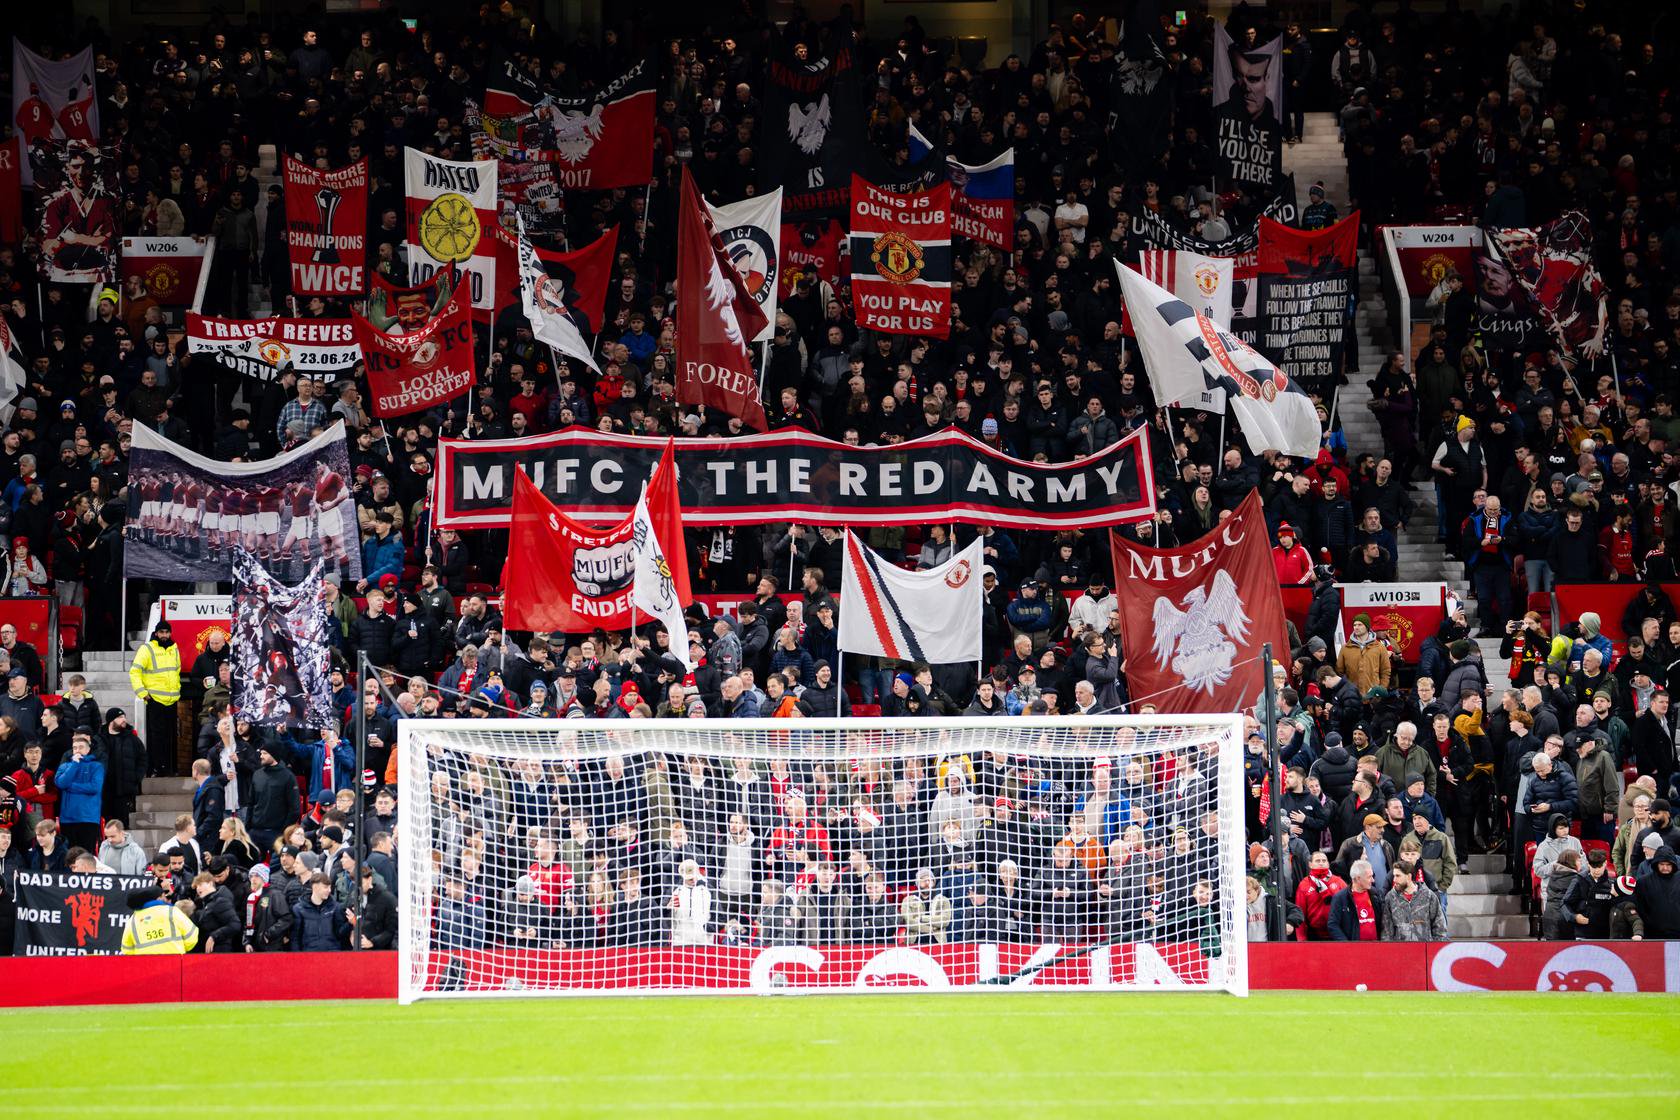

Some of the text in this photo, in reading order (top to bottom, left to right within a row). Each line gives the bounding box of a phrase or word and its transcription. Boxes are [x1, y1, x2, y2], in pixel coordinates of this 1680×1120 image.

[594, 59, 646, 102] ARMY
[32, 107, 41, 122] 9
[69, 111, 84, 127] 19
[1248, 123, 1270, 149] SE
[1219, 138, 1248, 160] YOU
[288, 171, 316, 186] THAN
[325, 162, 366, 182] MORE
[424, 158, 481, 194] HATED
[807, 166, 825, 189] IS
[1231, 160, 1273, 185] THERE
[529, 184, 552, 200] UNITED
[866, 186, 930, 209] THIS IS
[856, 201, 945, 225] OUR CLUB
[145, 243, 178, 253] W206
[289, 231, 364, 250] CHAMPIONS
[1422, 233, 1455, 243] W204
[788, 250, 826, 268] MUFC
[291, 263, 364, 292] TWICE
[413, 262, 483, 303] ADRD
[1270, 279, 1348, 299] WHEN THE SEAGULLS
[859, 294, 944, 313] YOU PLAY
[1266, 300, 1299, 315] FOLLOW
[1300, 299, 1313, 314] THE
[202, 320, 354, 342] TRACEY REEVES
[866, 313, 934, 330] FOR US
[1271, 311, 1344, 331] IT IS BECAUSE THEY
[1265, 333, 1291, 348] THINK
[1290, 329, 1328, 346] SARDINES
[300, 351, 357, 365] 23.06.24
[1283, 345, 1331, 361] BE THROWN
[216, 352, 279, 382] FOREVE
[1300, 362, 1316, 377] THE
[1317, 361, 1333, 376] SEA
[400, 365, 455, 395] LOYAL
[684, 361, 762, 406] FOREV
[378, 370, 471, 411] SUPPORTER
[462, 458, 1124, 503] MUFC THE RED ARMY
[548, 513, 634, 547] STRETFO
[1374, 591, 1411, 602] W103
[19, 872, 53, 887] DAD
[58, 874, 113, 890] LOVES
[17, 906, 131, 928] MORE TH
[145, 929, 165, 940] 536
